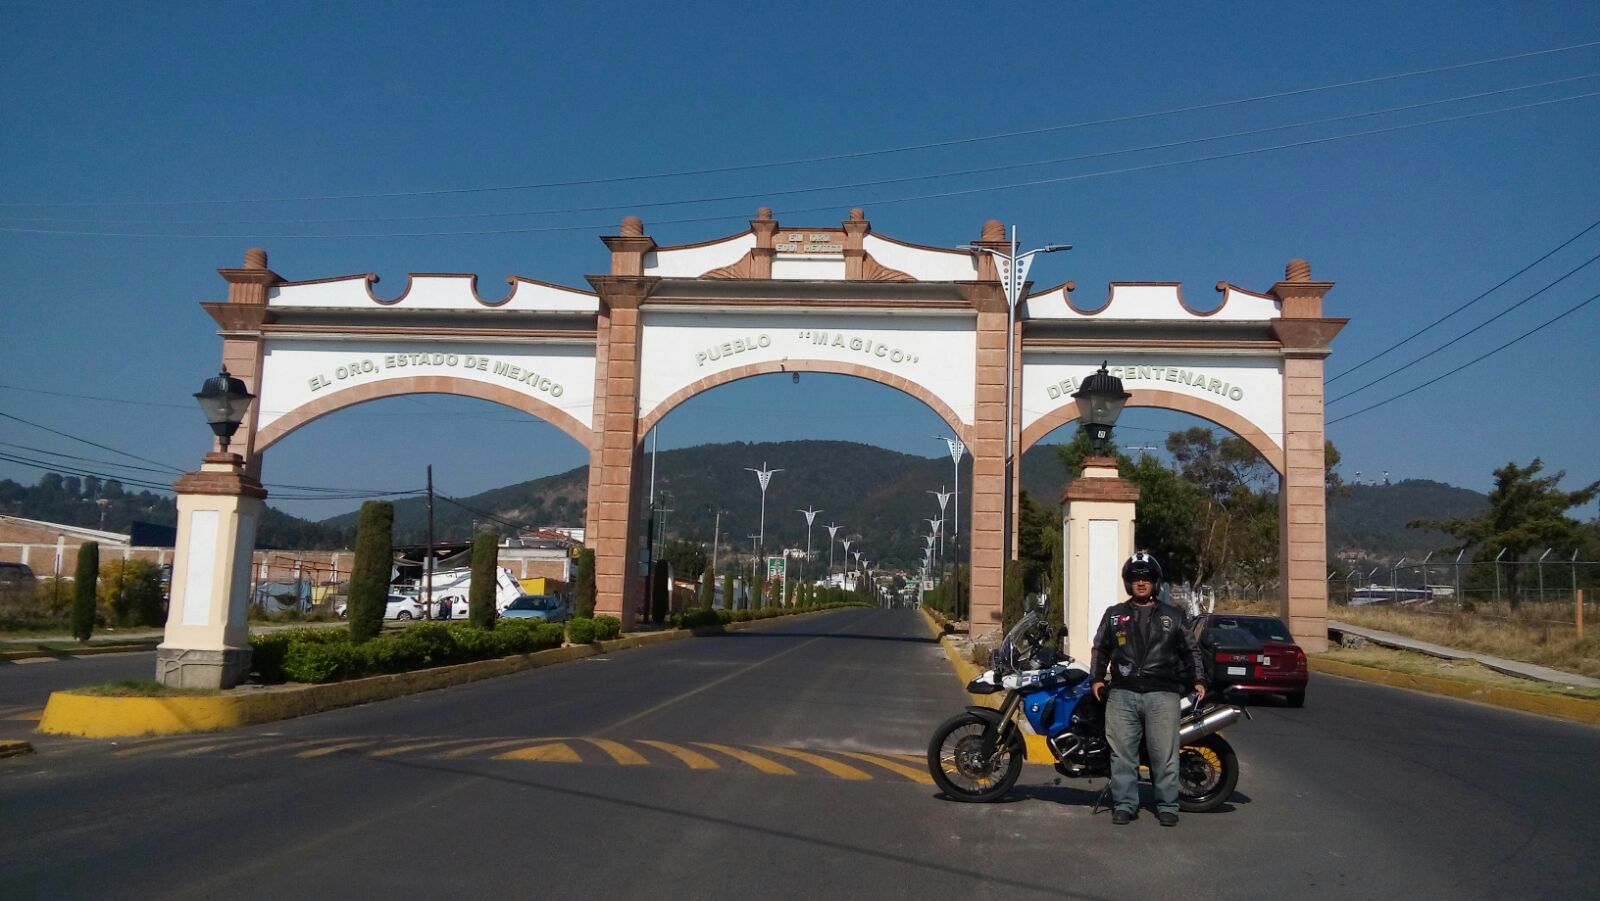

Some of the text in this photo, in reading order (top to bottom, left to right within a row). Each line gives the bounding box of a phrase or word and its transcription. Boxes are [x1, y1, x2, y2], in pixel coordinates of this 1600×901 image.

[694, 333, 771, 367] PUEBLO
[307, 352, 564, 398] EL ORO, ESTADO DE MEXICO
[1047, 364, 1244, 402] DEL CENTENARIO
